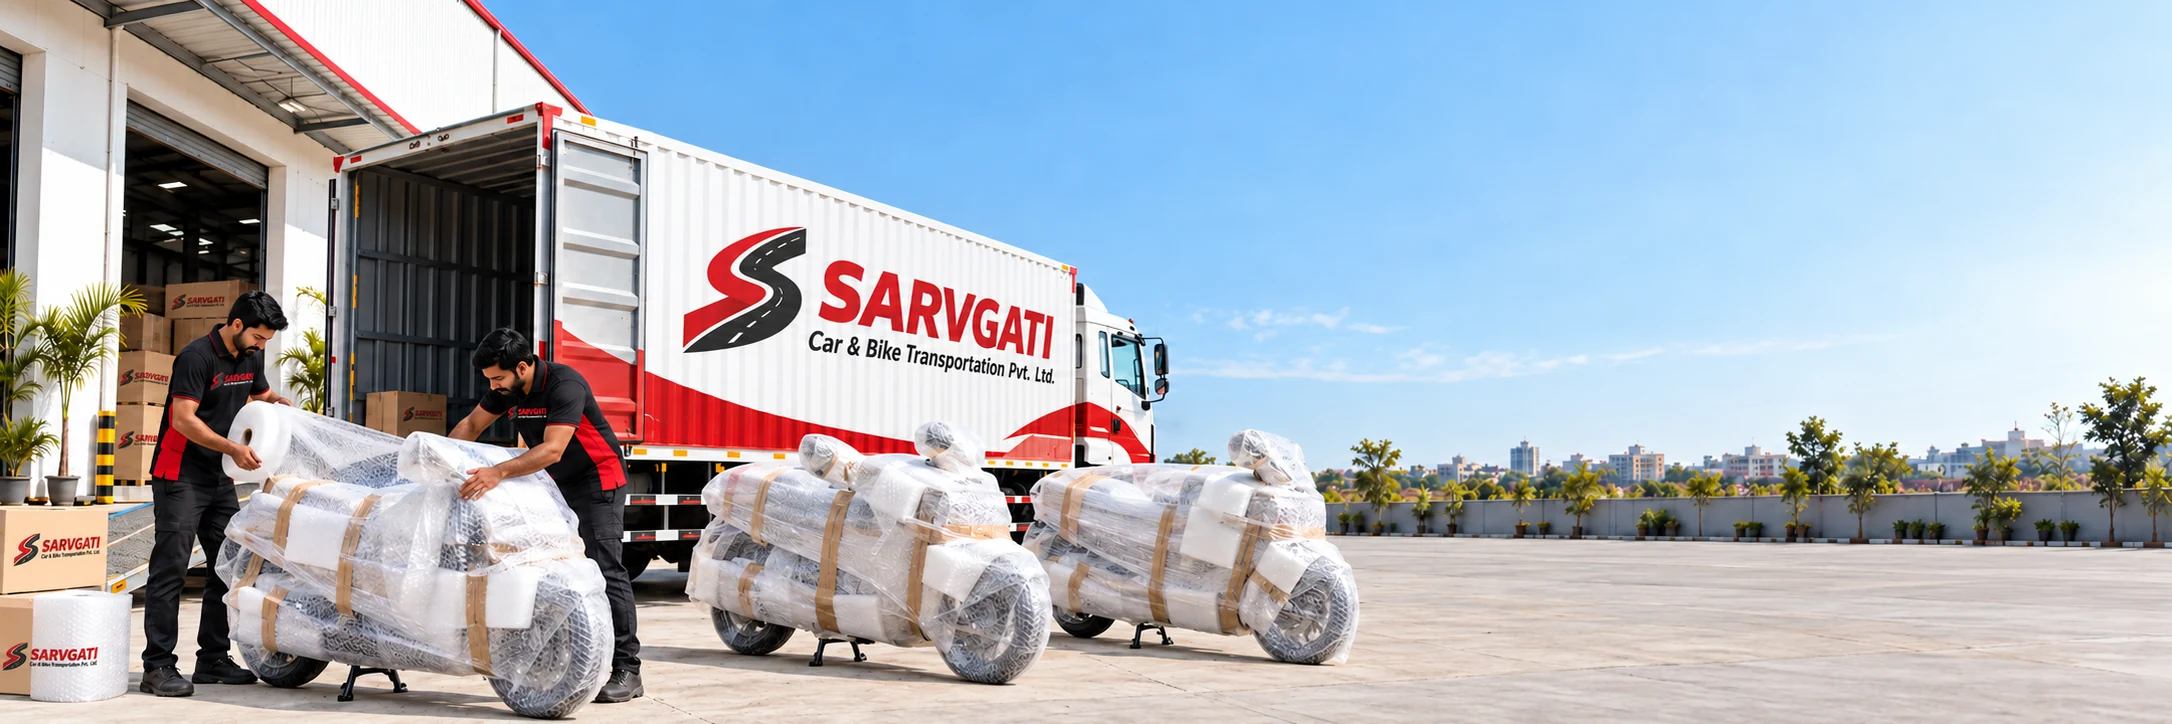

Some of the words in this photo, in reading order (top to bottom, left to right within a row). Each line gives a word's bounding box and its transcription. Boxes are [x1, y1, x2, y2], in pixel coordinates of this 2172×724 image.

[818, 259, 1054, 360] SARVGATI
[808, 330, 844, 354] Car
[847, 336, 861, 357] &
[865, 338, 902, 362] Bike
[906, 343, 1005, 377] Transportation
[1008, 362, 1031, 381] Pvt.
[1034, 366, 1055, 384] Ltd.
[42, 536, 100, 553] SARVGATI
[30, 647, 98, 662] SARVGATI
